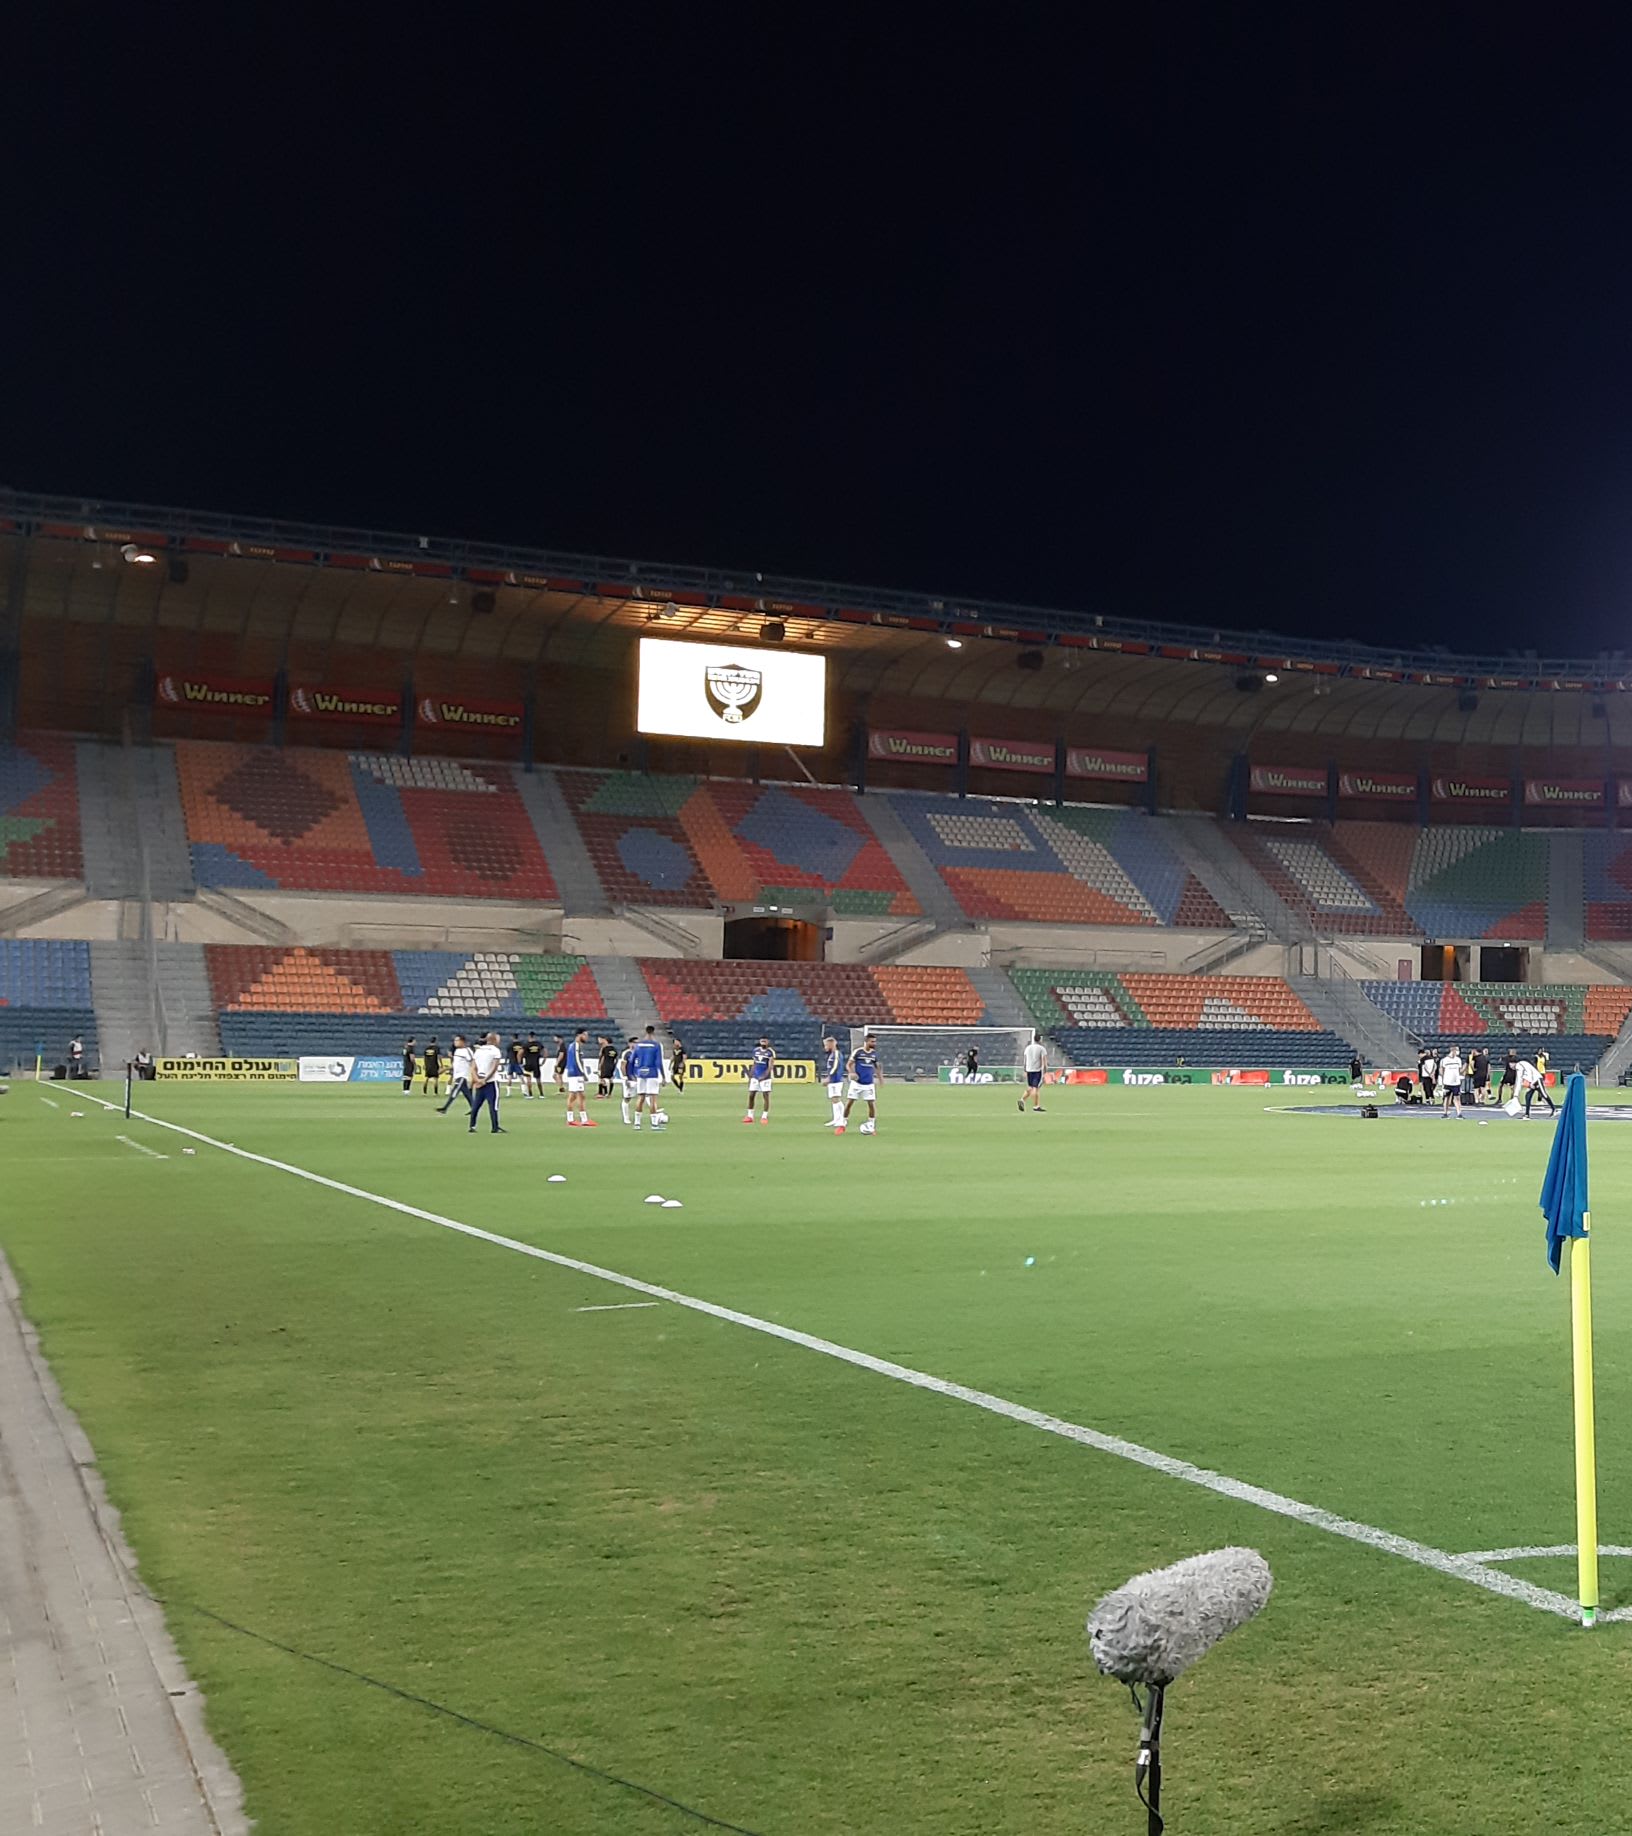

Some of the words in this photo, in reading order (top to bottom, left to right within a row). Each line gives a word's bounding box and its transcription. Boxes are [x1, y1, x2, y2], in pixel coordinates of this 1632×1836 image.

[163, 1061, 226, 1071] החימום
[231, 1059, 272, 1071] עולם
[773, 1064, 807, 1078] מוס
